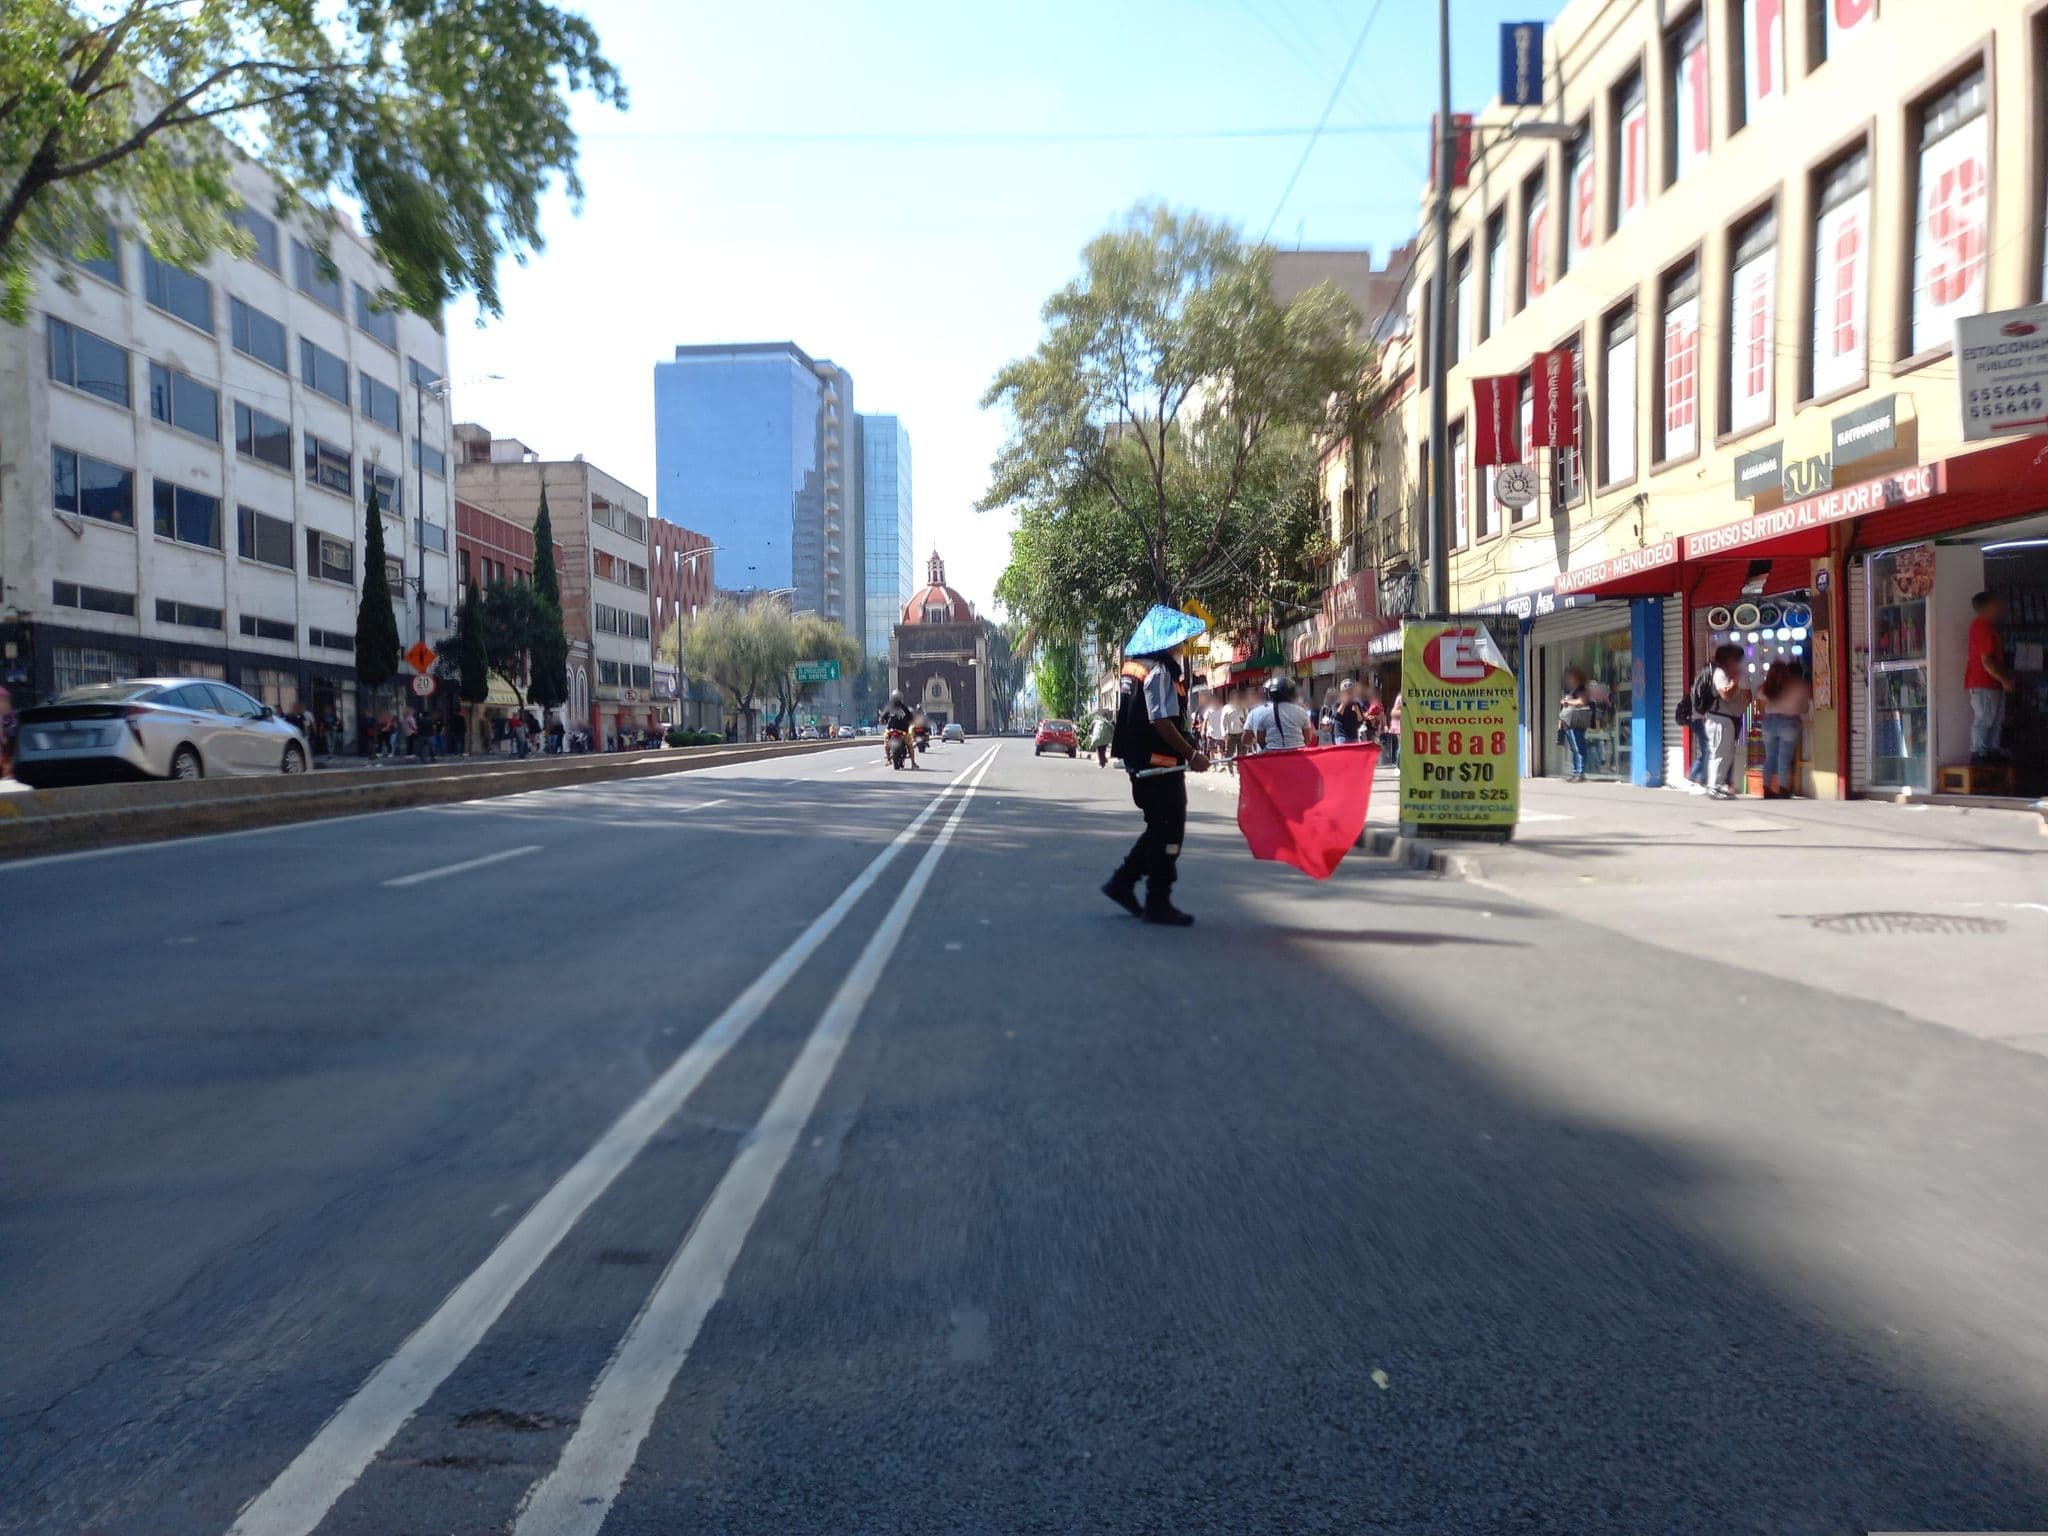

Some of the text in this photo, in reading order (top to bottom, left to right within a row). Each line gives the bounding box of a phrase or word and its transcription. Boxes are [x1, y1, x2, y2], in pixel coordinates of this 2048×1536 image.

[1690, 467, 1937, 556] EXTENSO SURTIDO AL MEJOR PRECIO
[1558, 563, 1607, 594] MAYOREO
[1613, 542, 1674, 577] MENUDEO
[1439, 636, 1485, 678] E
[1408, 688, 1514, 698] ESTACIONAMIENTOS
[1413, 731, 1506, 755] DE 8 a 8
[1423, 761, 1494, 783] Por $70
[1409, 788, 1509, 800] Por hora $25
[1404, 803, 1514, 812] PRECIO ESPECIAL
